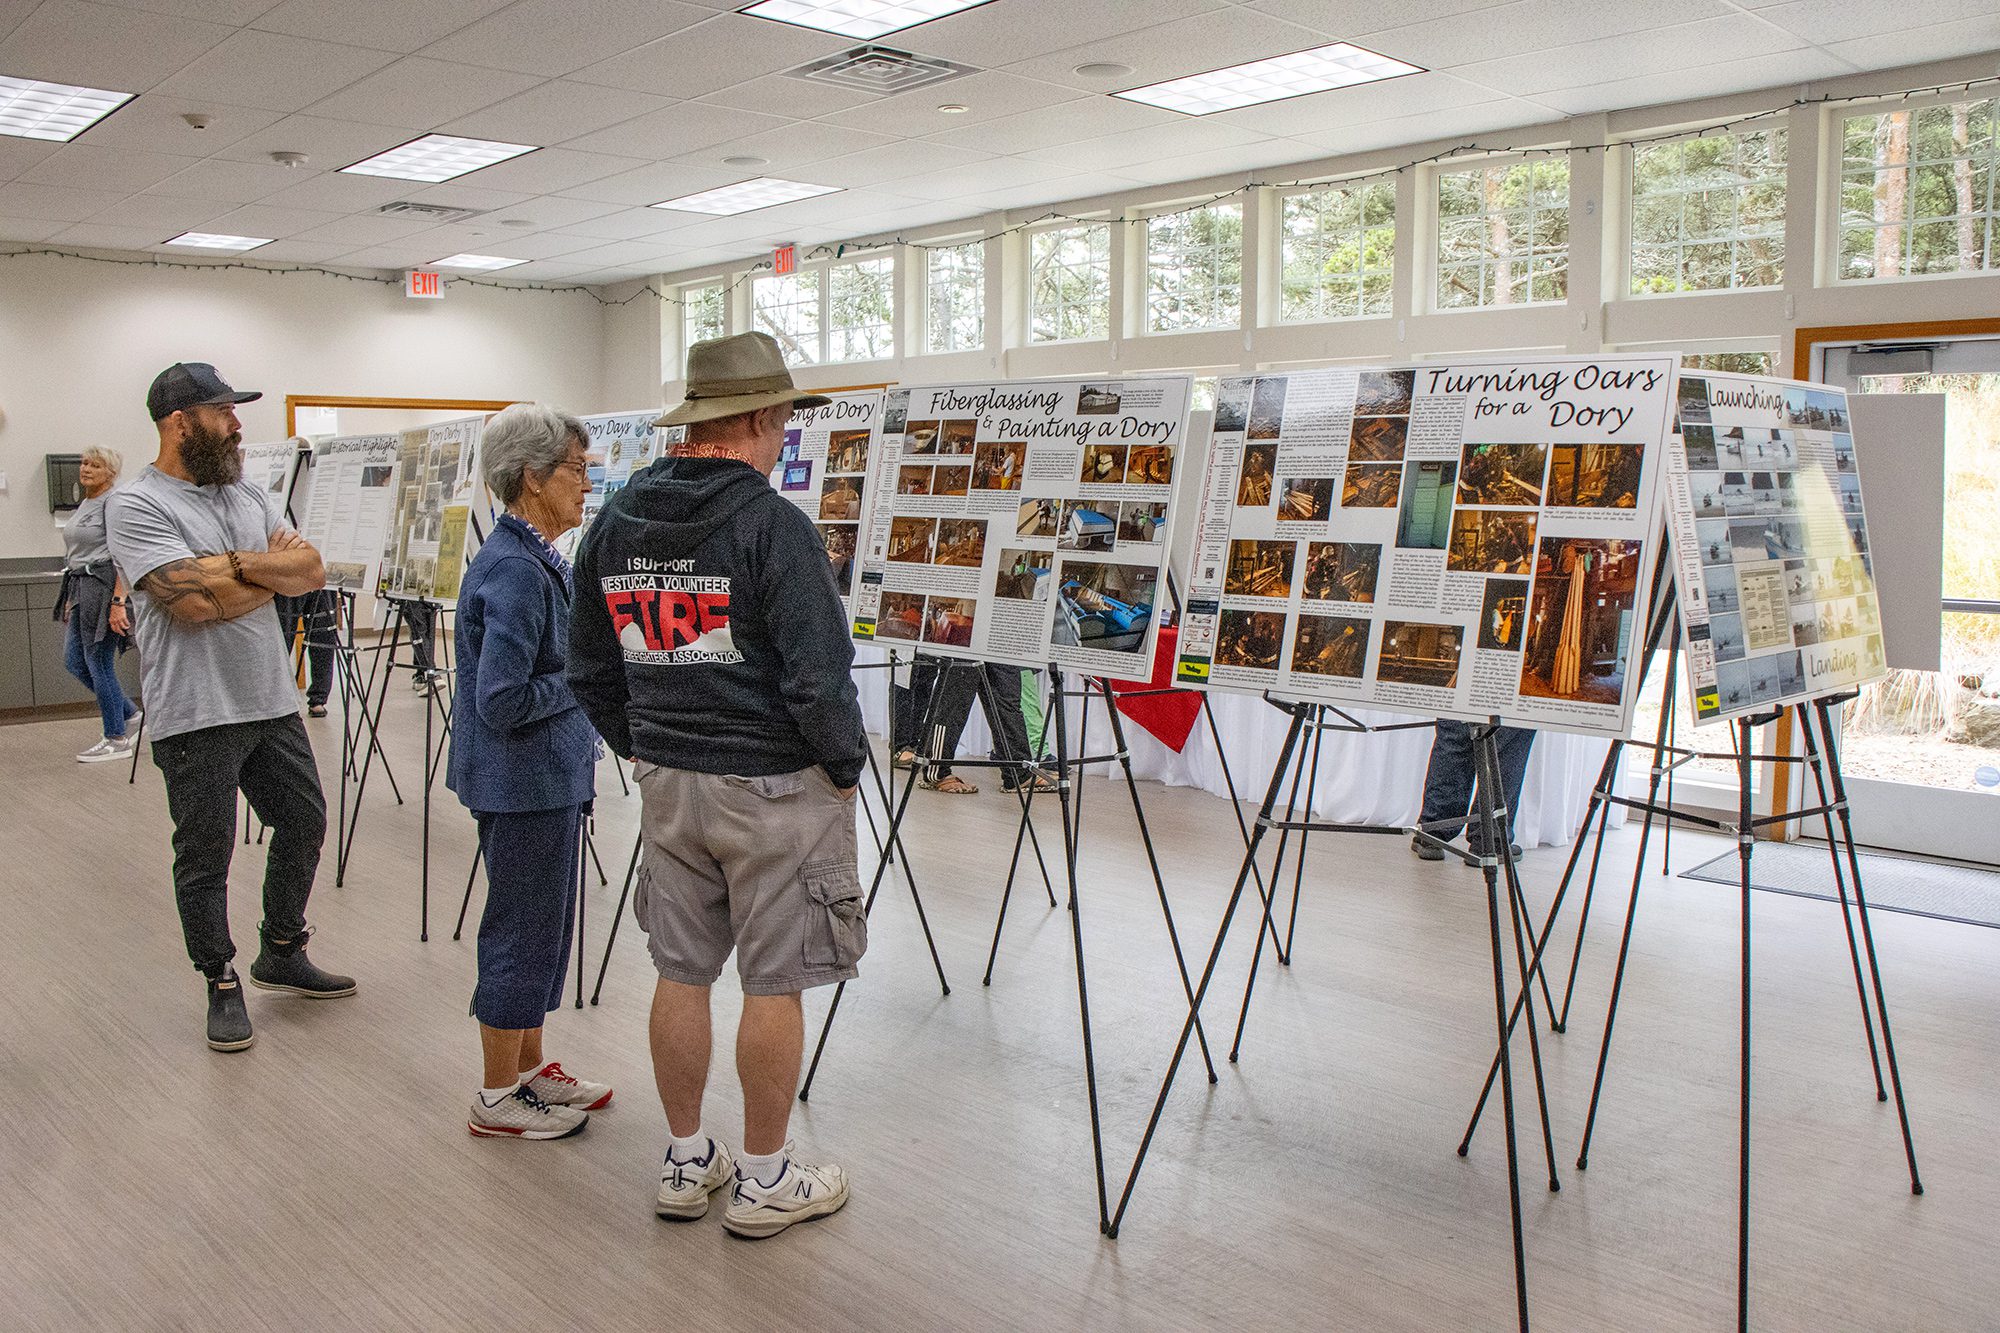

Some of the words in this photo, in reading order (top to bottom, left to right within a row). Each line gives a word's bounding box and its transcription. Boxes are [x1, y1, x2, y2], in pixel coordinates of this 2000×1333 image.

[775, 246, 794, 274] EXIT
[412, 271, 439, 295] EXIT
[1429, 367, 1569, 400] Turning
[1574, 364, 1663, 391] Oars
[821, 406, 835, 420] a
[836, 401, 875, 423] Dory
[930, 388, 1063, 417] Fiberglassing
[1708, 382, 1784, 419] Launching
[606, 419, 632, 439] Days
[1474, 396, 1508, 419] for
[1512, 404, 1532, 416] a
[1549, 400, 1634, 434] Dory
[983, 414, 994, 430] &
[998, 415, 1096, 446] Painting
[1097, 420, 1118, 437] a
[1120, 415, 1177, 444] Dory
[627, 558, 631, 571] I
[633, 557, 696, 573] SUPPORT
[602, 576, 657, 593] NESTUCCA
[663, 576, 731, 593] VOLUNTEER
[605, 589, 730, 651] FIRE
[672, 650, 744, 663] ASSOCIATION
[1810, 648, 1857, 677] Landing
